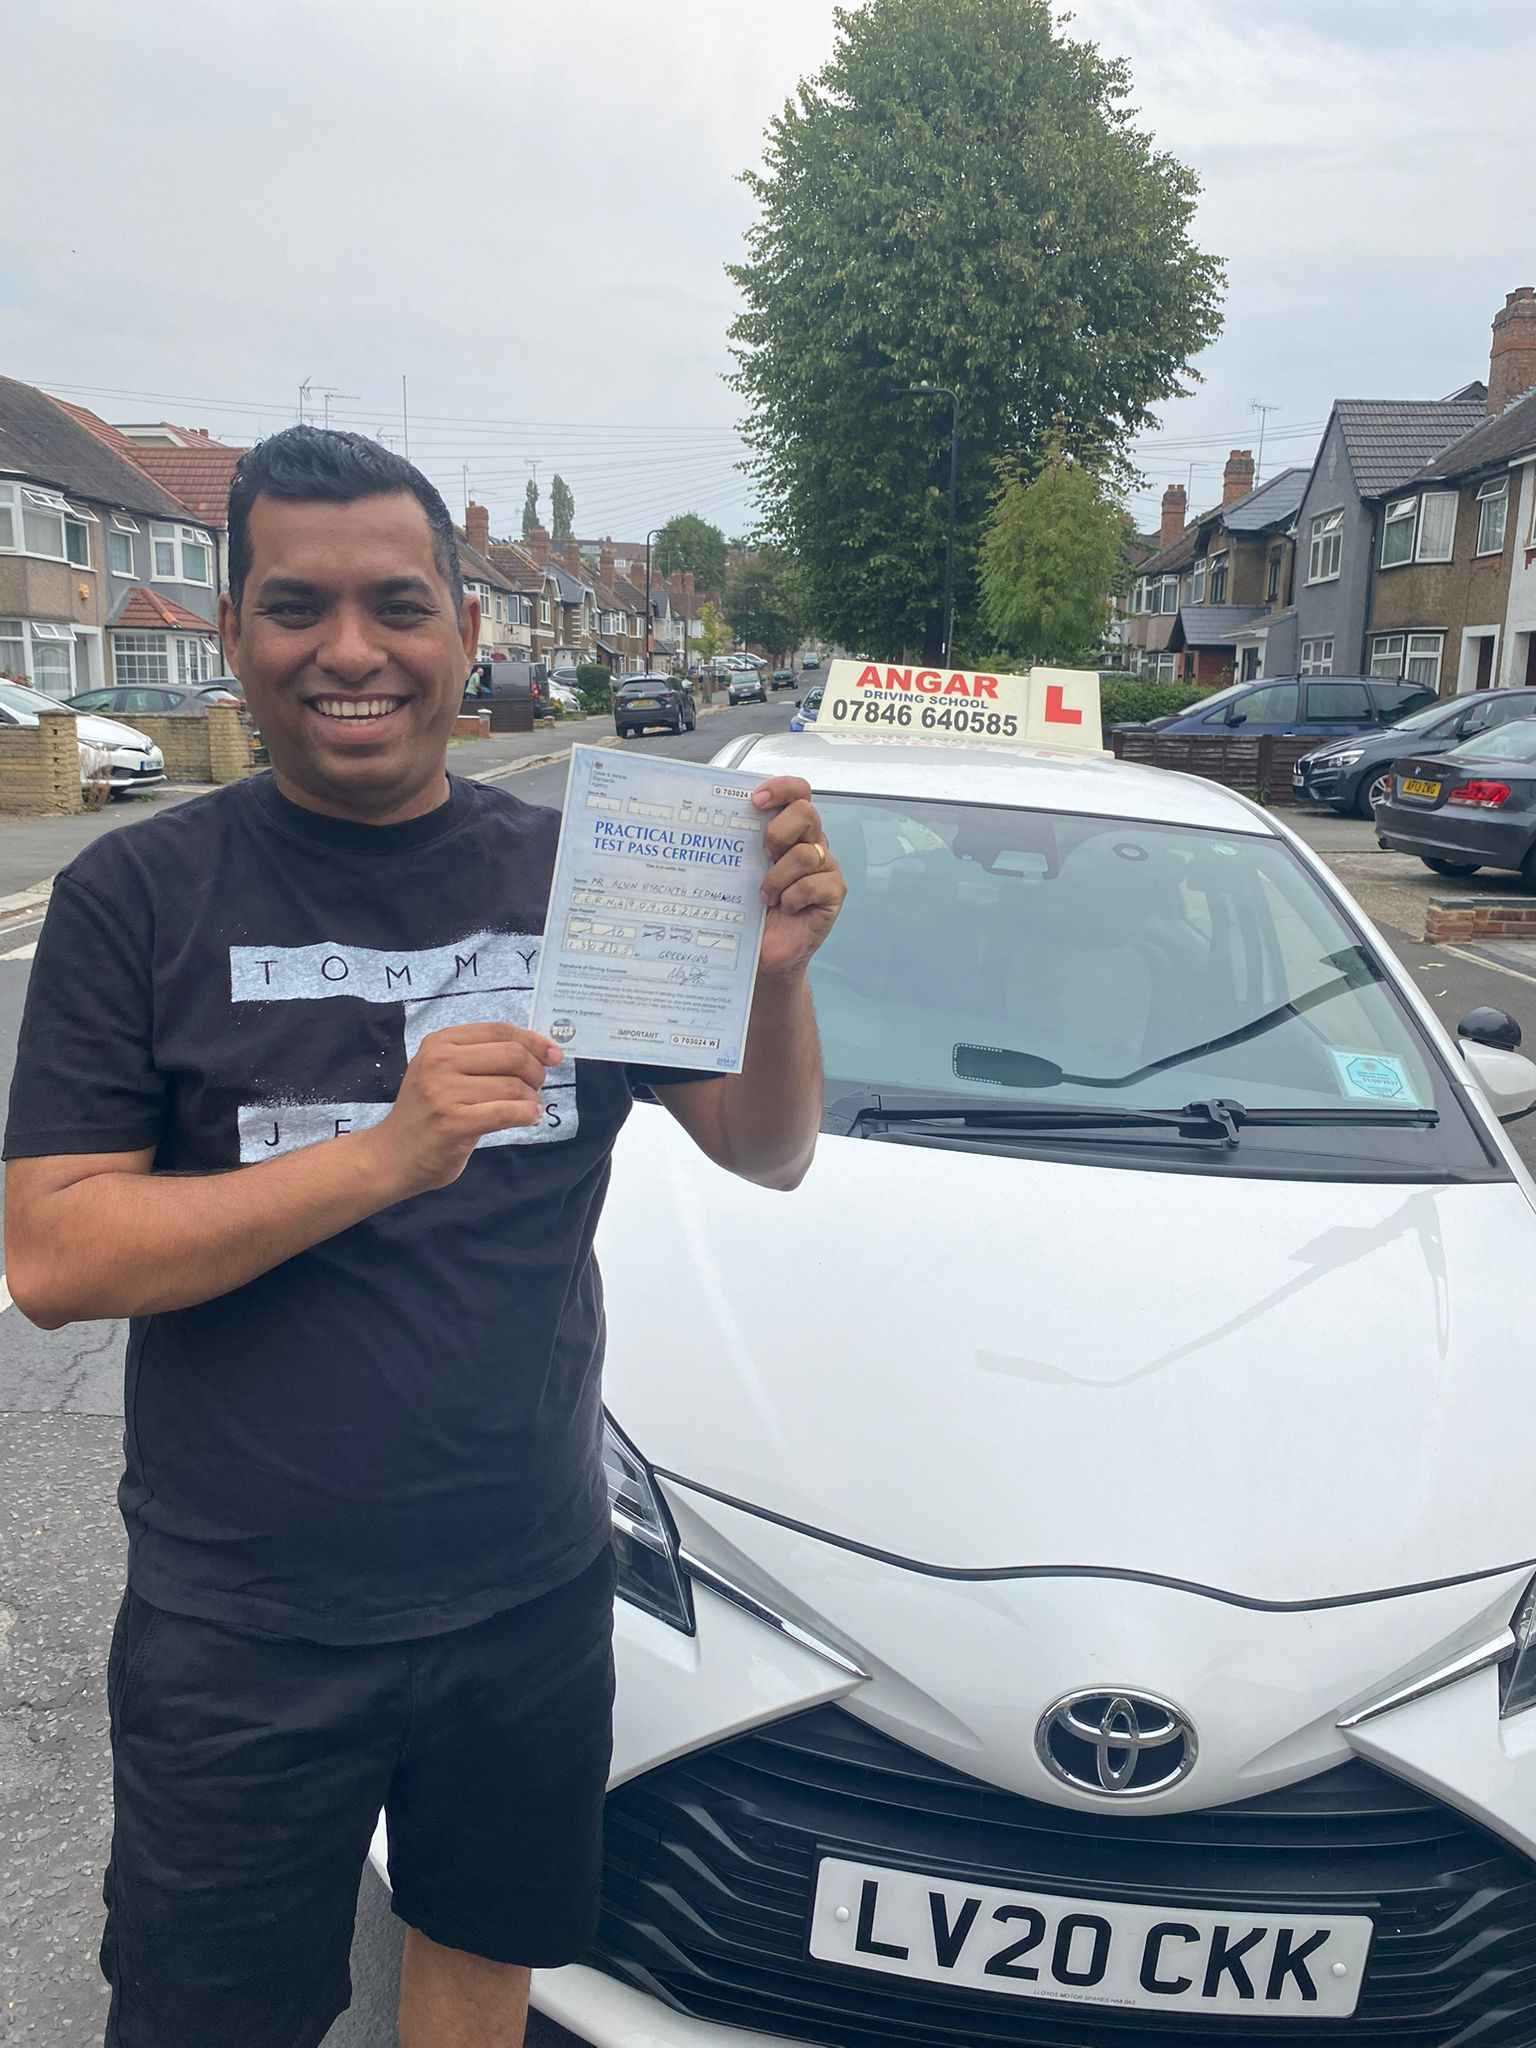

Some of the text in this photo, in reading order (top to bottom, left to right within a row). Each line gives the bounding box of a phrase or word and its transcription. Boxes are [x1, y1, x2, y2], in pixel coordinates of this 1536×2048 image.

[856, 665, 1000, 699] ANGAR
[864, 689, 989, 709] DRIVING SCHOOL
[833, 699, 1018, 737] 07846 640585
[1044, 685, 1083, 725] L
[593, 837, 742, 867] TEST PASS CERTIFICATE
[595, 821, 745, 853] PRACTICAL DRIVING
[256, 949, 538, 989] TOMMY
[618, 1028, 659, 1040] IMPORTANT
[681, 1037, 707, 1046] 703024
[264, 1103, 562, 1147] JES
[853, 1879, 1332, 2001] LV20 CKK
